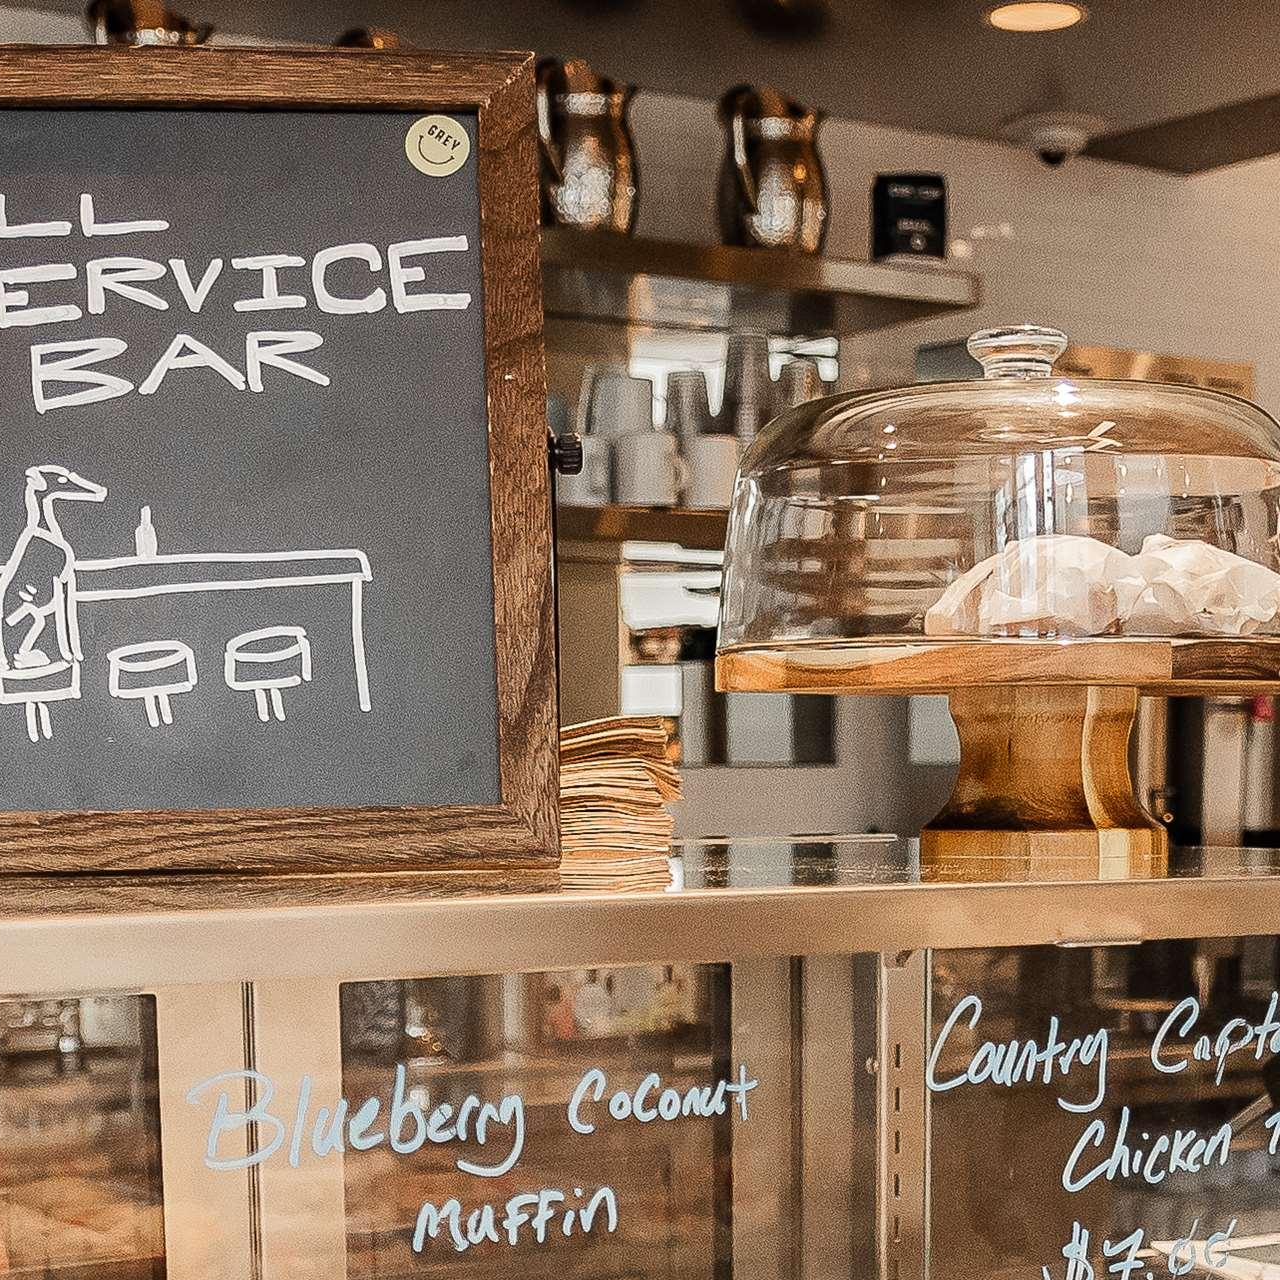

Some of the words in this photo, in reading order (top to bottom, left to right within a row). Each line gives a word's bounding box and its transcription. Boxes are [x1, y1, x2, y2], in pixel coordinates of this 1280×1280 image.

[427, 124, 461, 150] GREY
[29, 330, 331, 415] BAR
[926, 994, 1110, 1114] Country
[186, 1065, 526, 1178] Blueberry
[1061, 1105, 1234, 1193] Chicken
